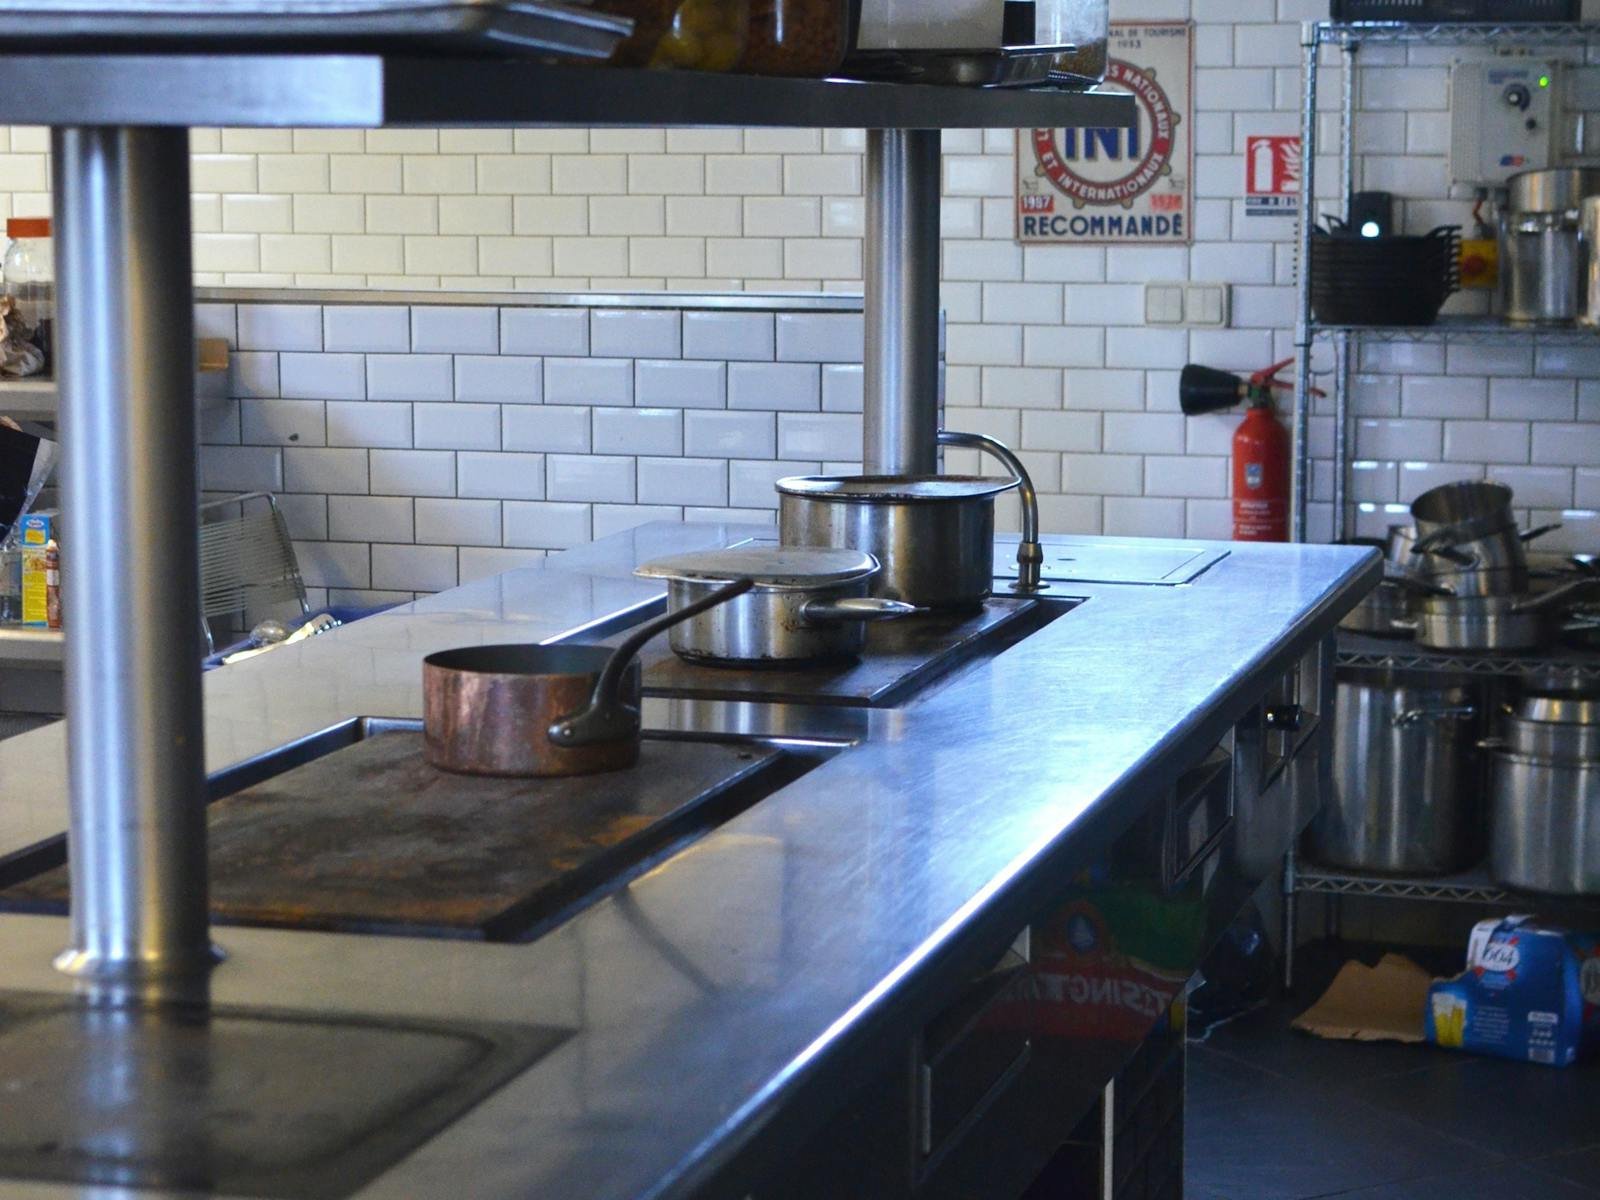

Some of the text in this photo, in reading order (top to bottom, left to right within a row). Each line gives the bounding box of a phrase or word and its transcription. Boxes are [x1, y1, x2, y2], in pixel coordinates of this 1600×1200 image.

[1123, 69, 1169, 140] NATIONAUX
[1041, 152, 1163, 200] ET INTERNATIONAUX
[1023, 214, 1183, 236] RECOMMANDÉ
